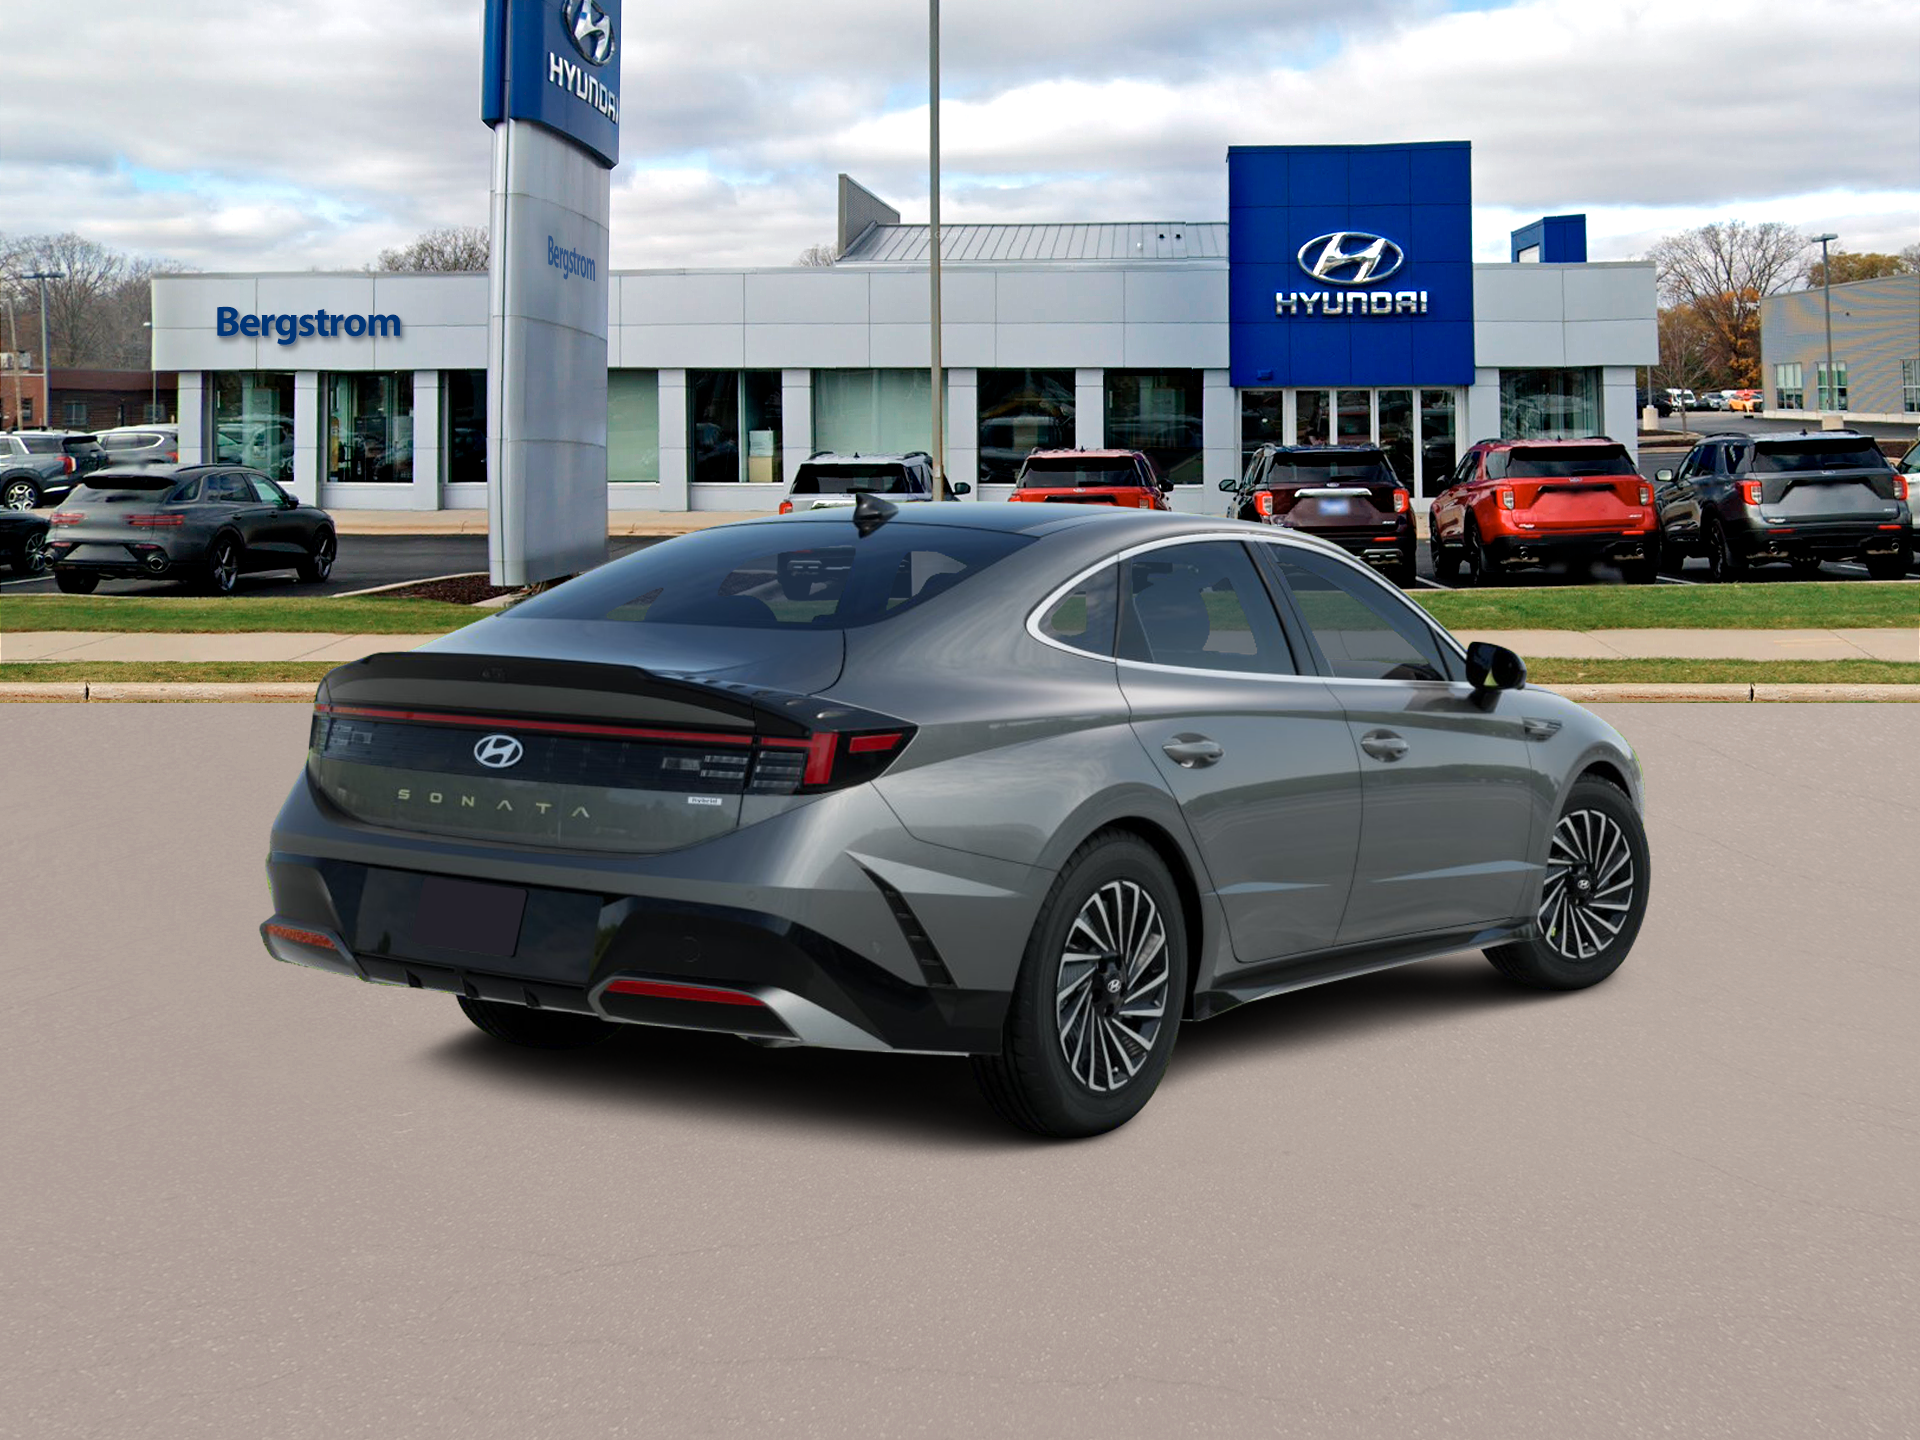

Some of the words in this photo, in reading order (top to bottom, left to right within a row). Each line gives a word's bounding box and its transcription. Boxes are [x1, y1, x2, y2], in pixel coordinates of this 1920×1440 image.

[549, 52, 619, 124] HYUNDAI
[548, 235, 596, 282] Bergstrom
[1276, 291, 1428, 315] HYUNDAI
[217, 306, 402, 346] Bergstrom
[398, 789, 590, 818] SONATA
